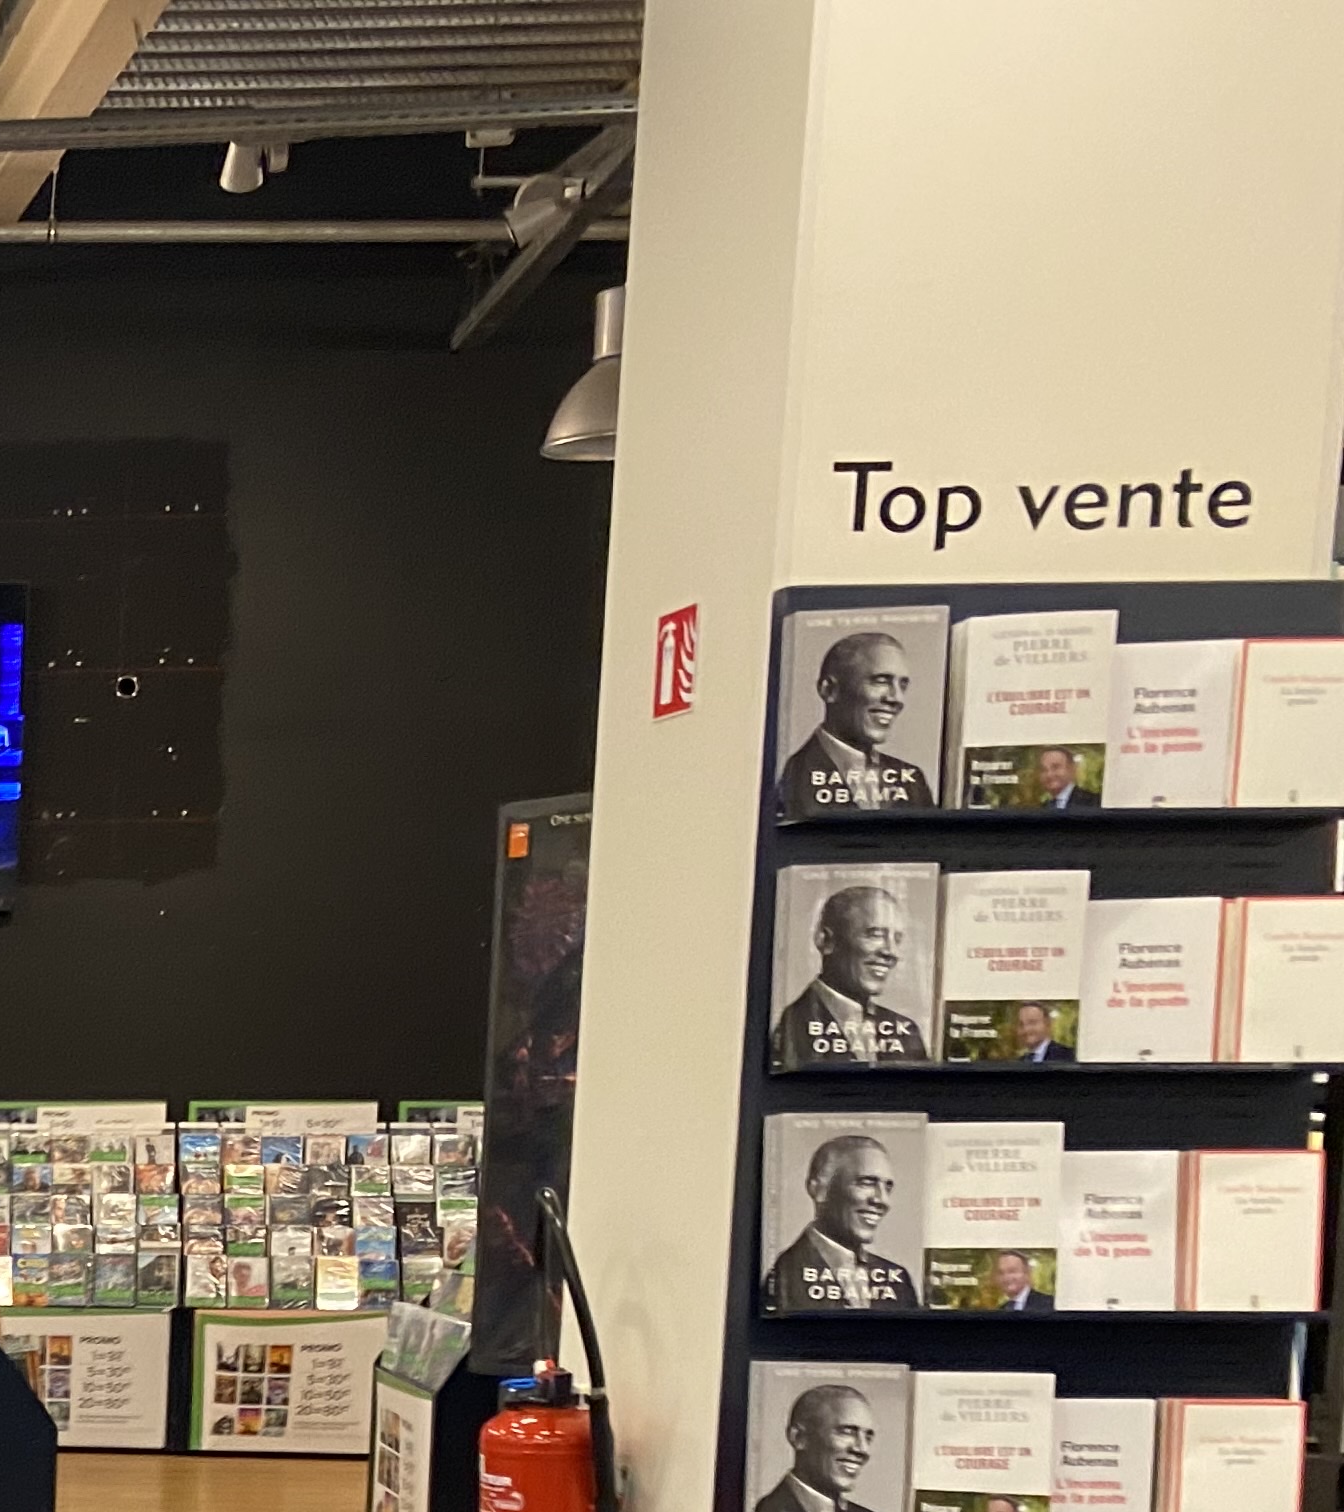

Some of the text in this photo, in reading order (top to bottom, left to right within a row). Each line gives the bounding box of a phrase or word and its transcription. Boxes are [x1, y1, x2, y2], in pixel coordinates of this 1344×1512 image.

[834, 461, 1252, 551] Top vente
[1013, 637, 1072, 651] PIERRE
[1015, 651, 1088, 665] VILLIERS
[1009, 702, 1067, 716] COURAGE
[811, 768, 916, 785] BARACK
[816, 787, 909, 804] OBAMA
[808, 1020, 912, 1036] BARACK
[812, 1039, 905, 1054] OBAMA
[802, 1267, 903, 1283] BARACK
[808, 1286, 898, 1300] OBAMA
